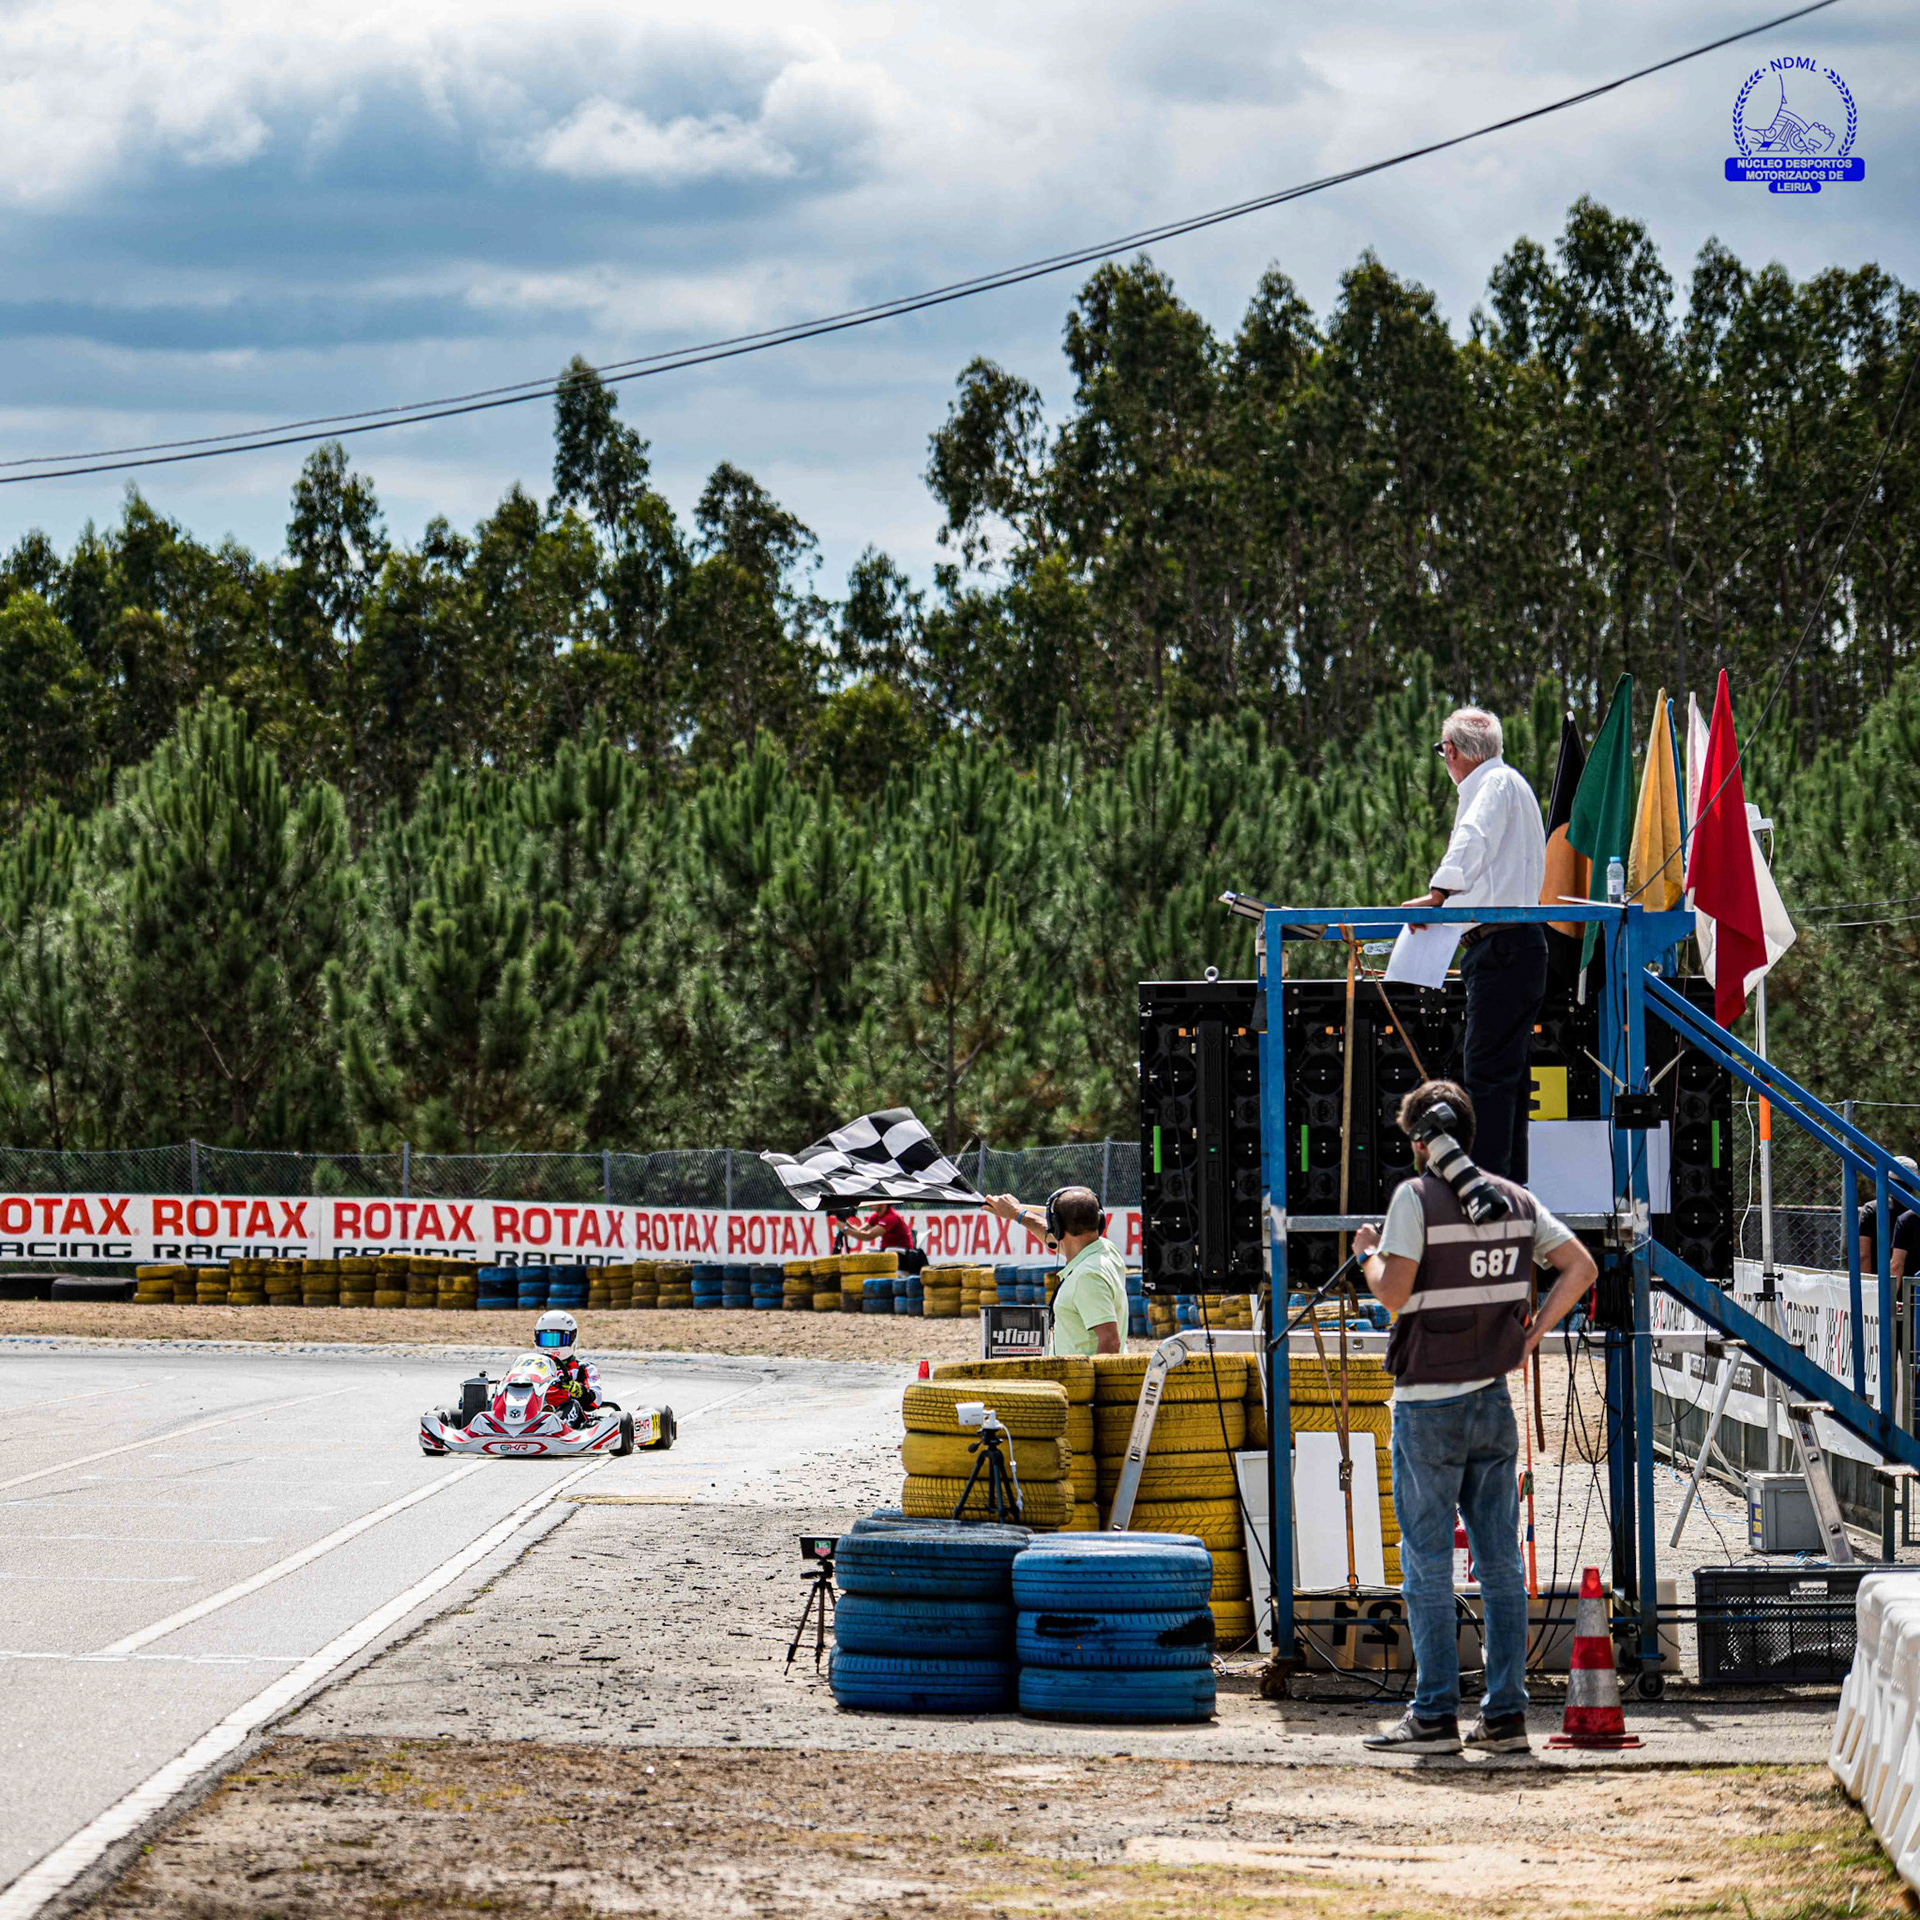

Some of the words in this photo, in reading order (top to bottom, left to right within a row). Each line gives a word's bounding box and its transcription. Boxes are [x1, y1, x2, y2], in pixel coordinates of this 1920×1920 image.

[153, 1199, 307, 1238] ROTAX
[334, 1202, 475, 1242] ROTAX
[493, 1206, 624, 1248] ROTAX
[636, 1212, 718, 1254] ROTAX
[728, 1216, 818, 1256] ROTAX
[926, 1215, 1011, 1256] ROTAX
[153, 1244, 307, 1258] RACING
[1470, 1247, 1519, 1278] 687
